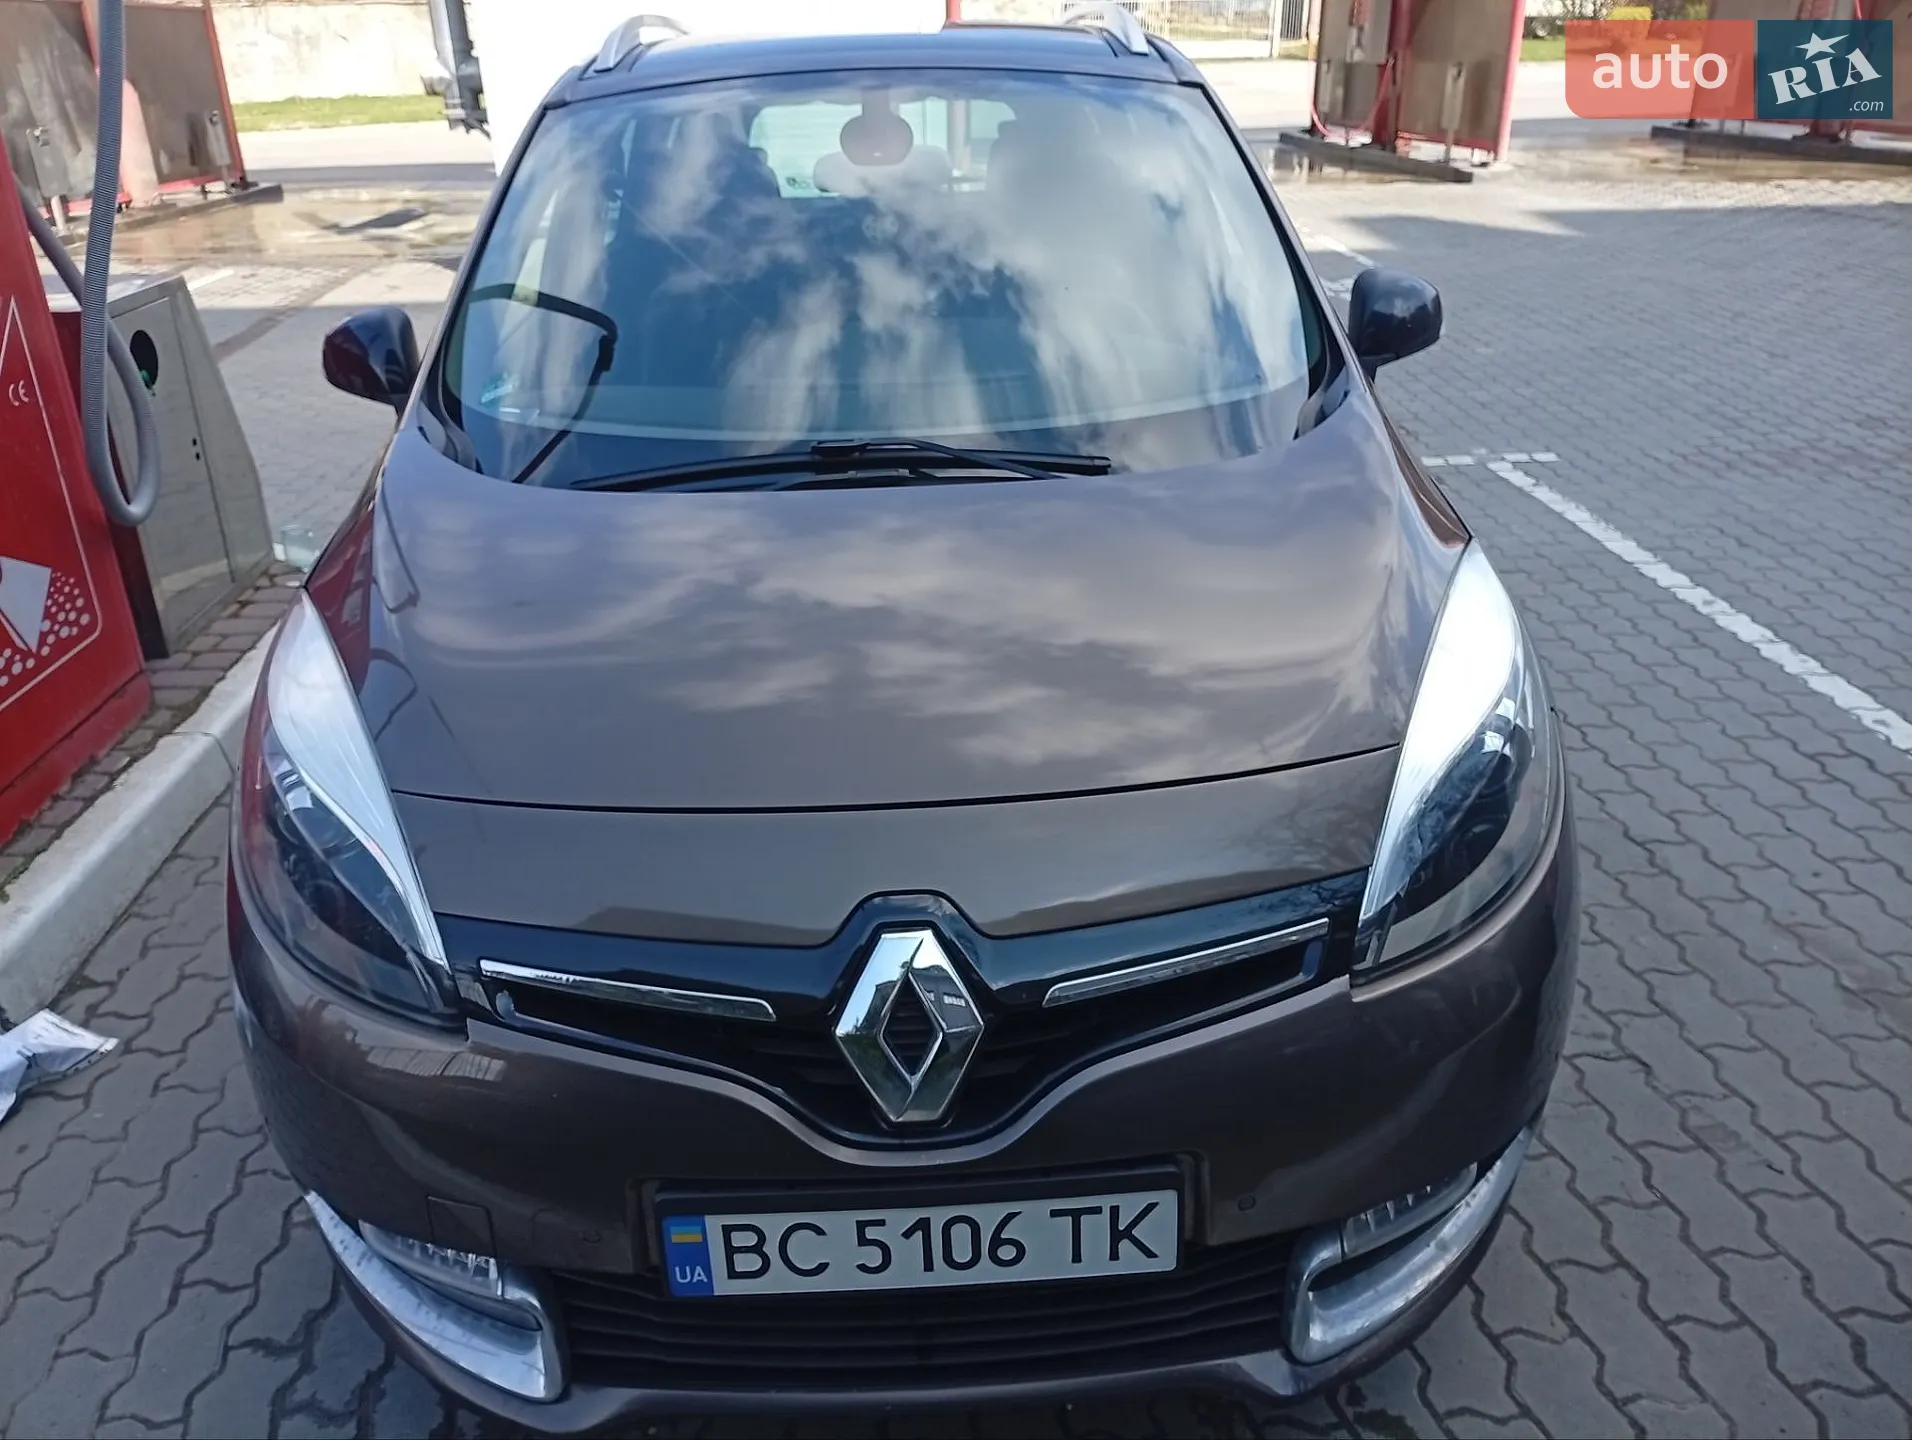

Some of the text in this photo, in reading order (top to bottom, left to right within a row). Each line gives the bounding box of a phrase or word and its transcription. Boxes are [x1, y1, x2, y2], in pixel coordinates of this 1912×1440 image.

[720, 1201, 1160, 1280] BC 5106 TK
[675, 1265, 708, 1285] UA
